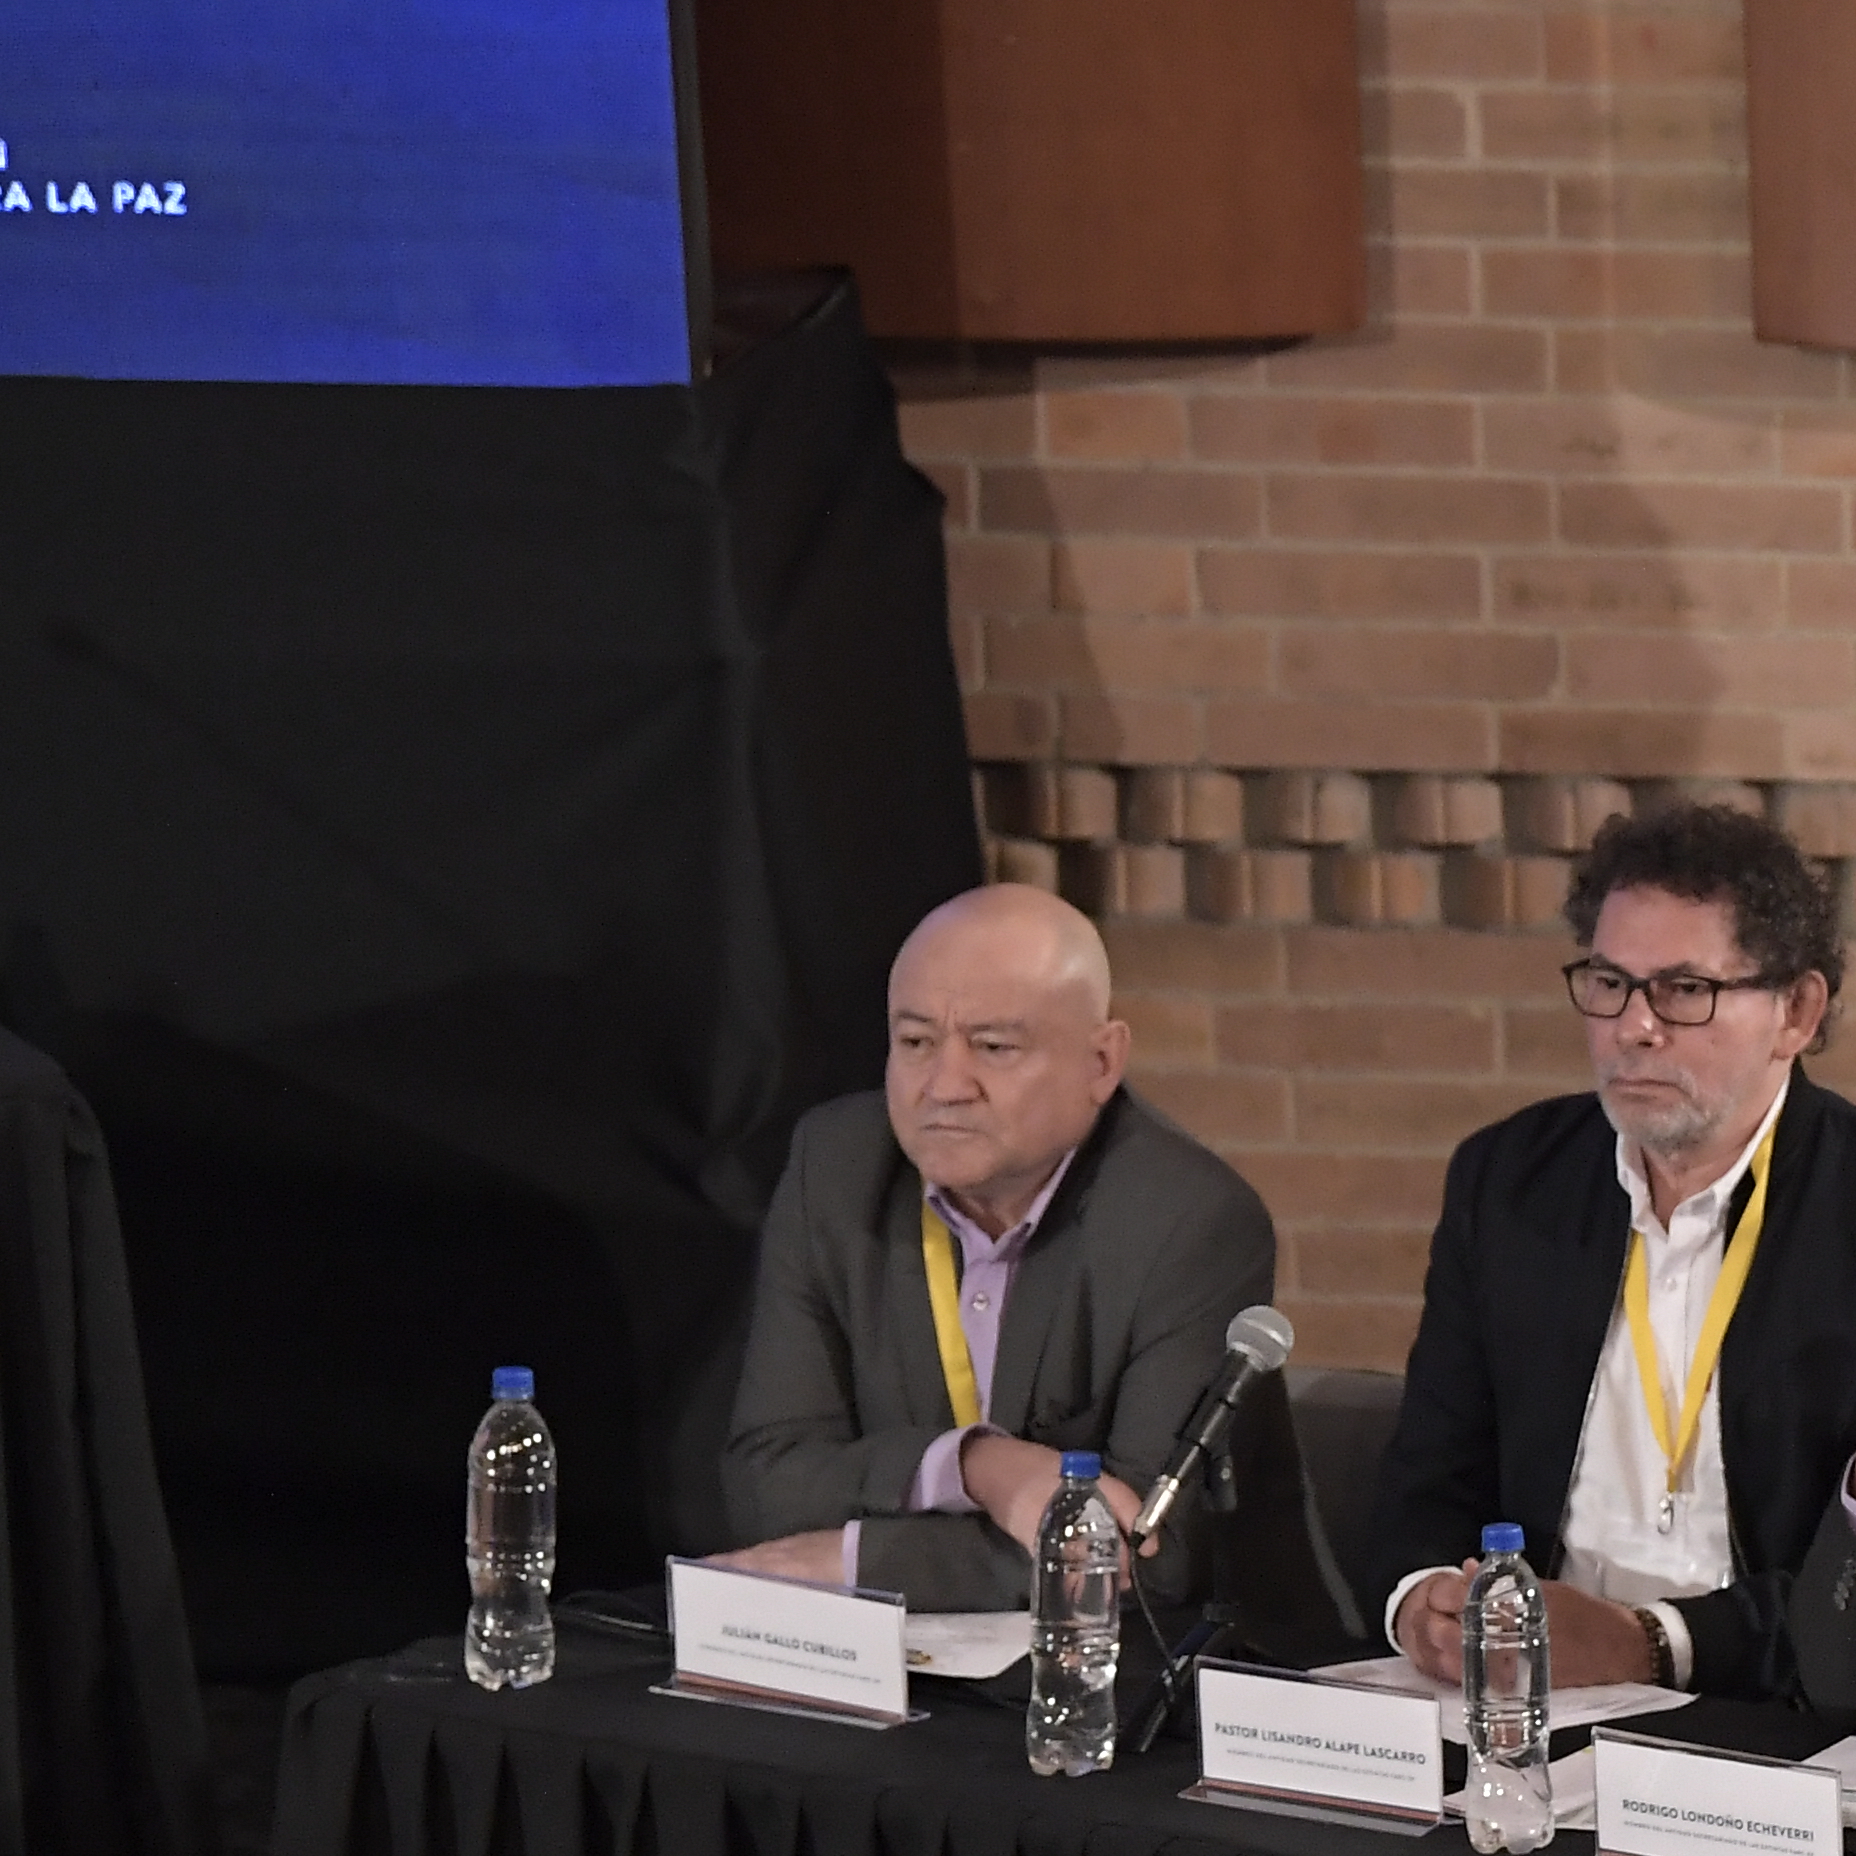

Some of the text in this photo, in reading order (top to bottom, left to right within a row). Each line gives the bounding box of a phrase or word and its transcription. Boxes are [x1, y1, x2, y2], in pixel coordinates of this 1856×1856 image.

[46, 180, 99, 215] LA
[112, 180, 188, 216] PAZ
[764, 1633, 799, 1650] GALLO
[1214, 1723, 1426, 1764] PASTOR LISANDRO ALAPE LASCARRO
[1622, 1799, 1814, 1841] RODRIGO LONDOÑO ECHEVERRI
